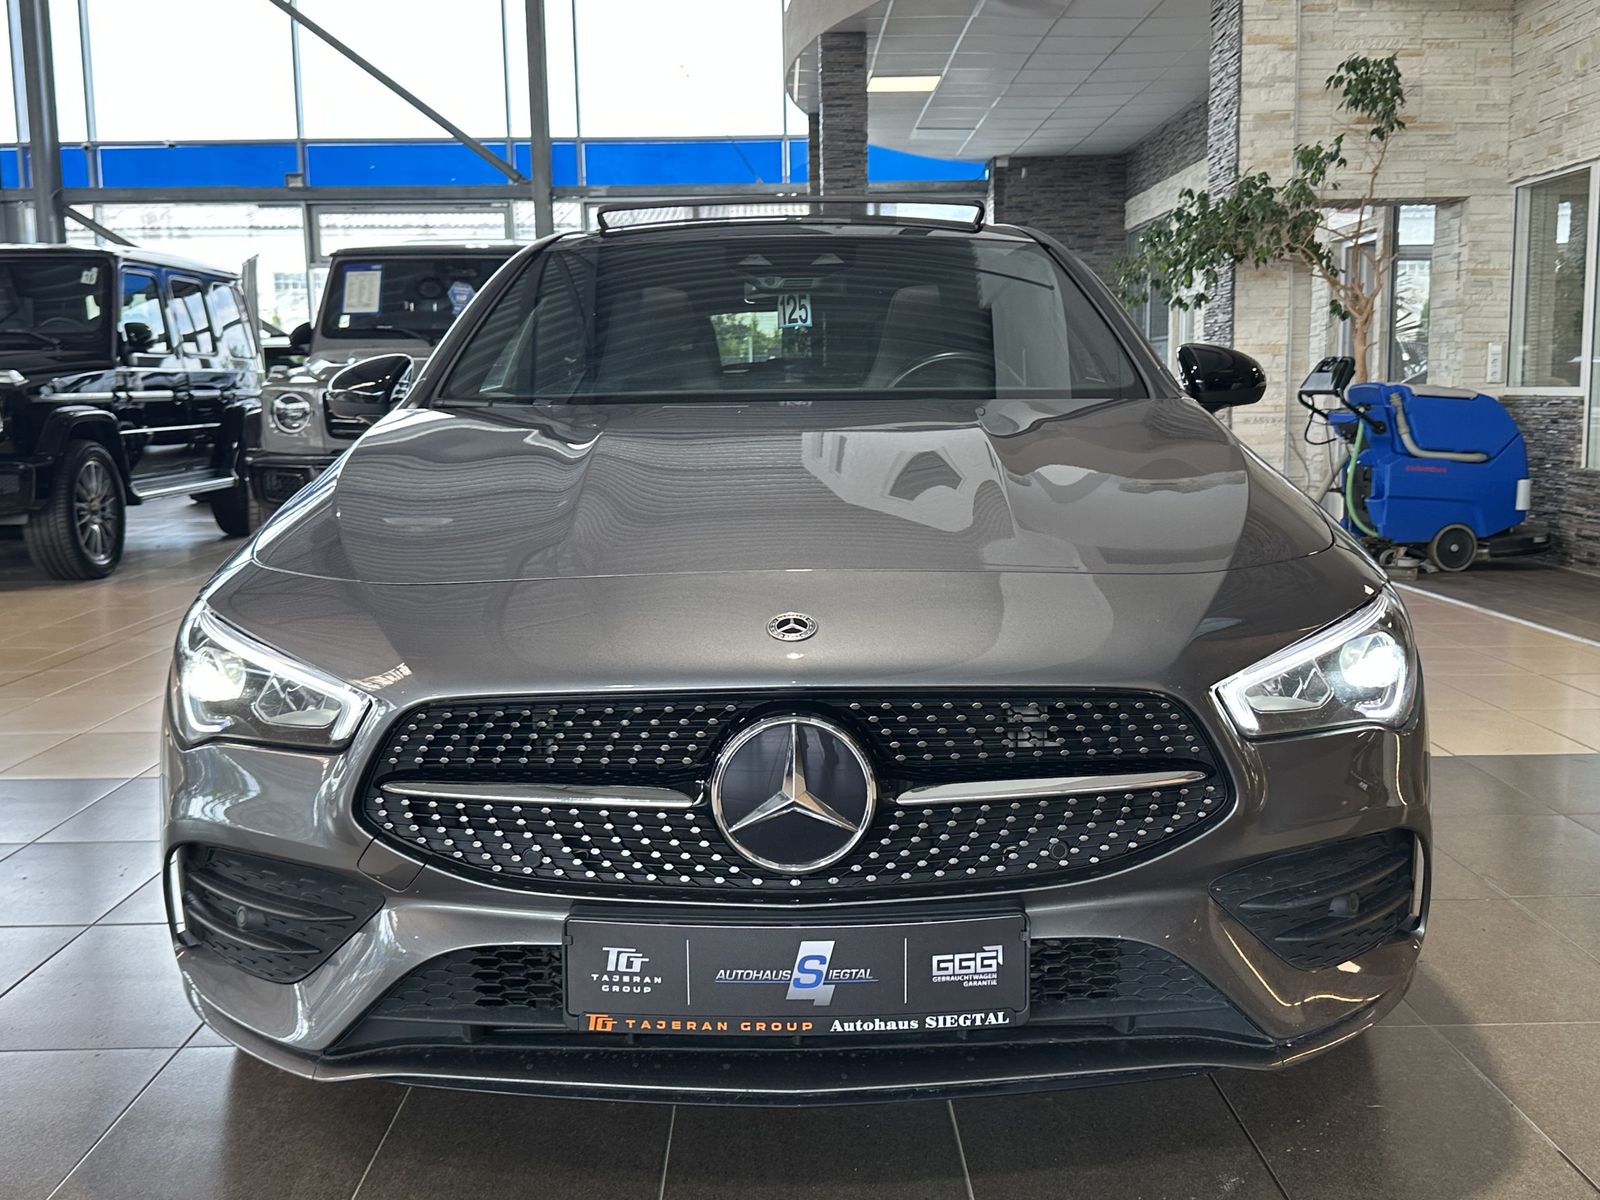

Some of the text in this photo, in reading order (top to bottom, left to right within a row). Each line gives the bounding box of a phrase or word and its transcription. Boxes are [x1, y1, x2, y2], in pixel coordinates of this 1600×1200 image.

[780, 295, 808, 325] 125
[932, 951, 998, 976] GGG
[591, 973, 662, 984] TAJERAN
[714, 969, 792, 981] AUTOHAUS
[932, 973, 998, 983] GEBRAUCHTWAGEN
[601, 984, 652, 994] GROUP
[963, 980, 998, 988] GARANTIE
[625, 1019, 728, 1031] TAJERAN
[740, 1021, 813, 1032] GROUP
[830, 1011, 1010, 1033] Autohaus SIEGTAL
